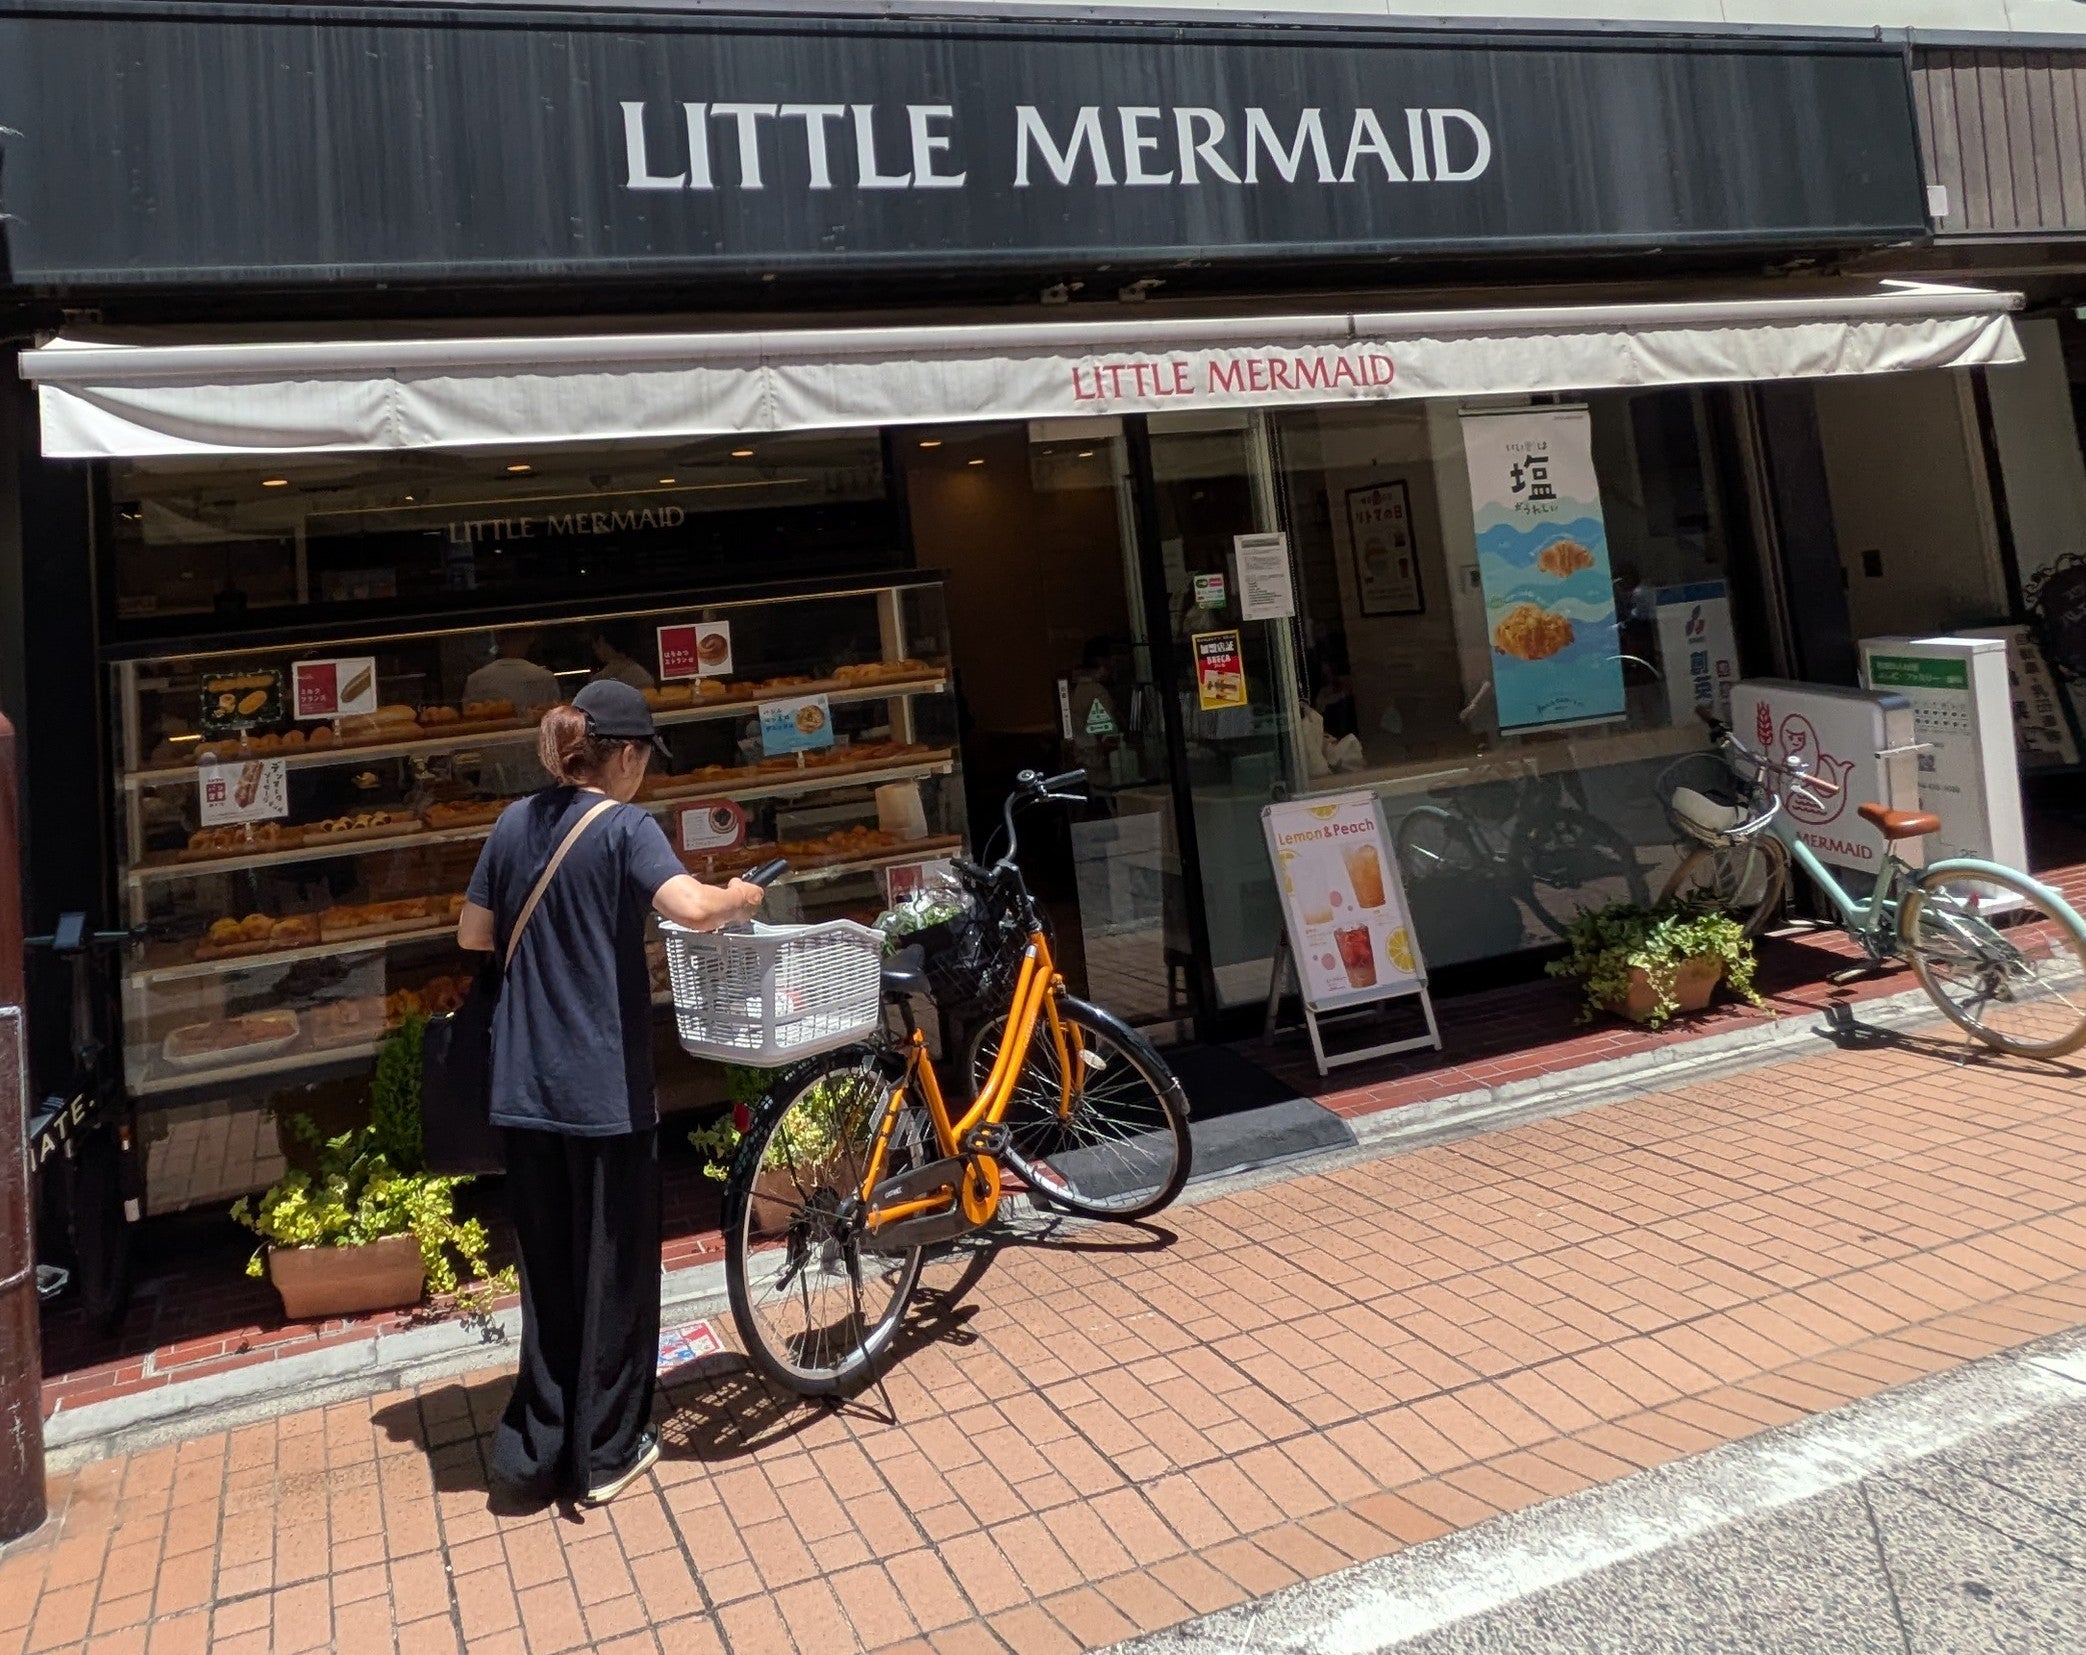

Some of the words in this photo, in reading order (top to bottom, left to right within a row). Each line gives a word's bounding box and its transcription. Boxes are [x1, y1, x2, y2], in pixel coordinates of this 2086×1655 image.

[619, 101, 967, 190] LITTLE
[1013, 105, 1492, 186] MERMAID
[1072, 361, 1195, 400] LITTLE
[1207, 354, 1395, 393] MERMAID
[1510, 454, 1557, 501] 塩
[449, 517, 535, 543] LITTLE
[549, 506, 685, 536] MERMAID
[30, 1093, 95, 1173] ATE.
